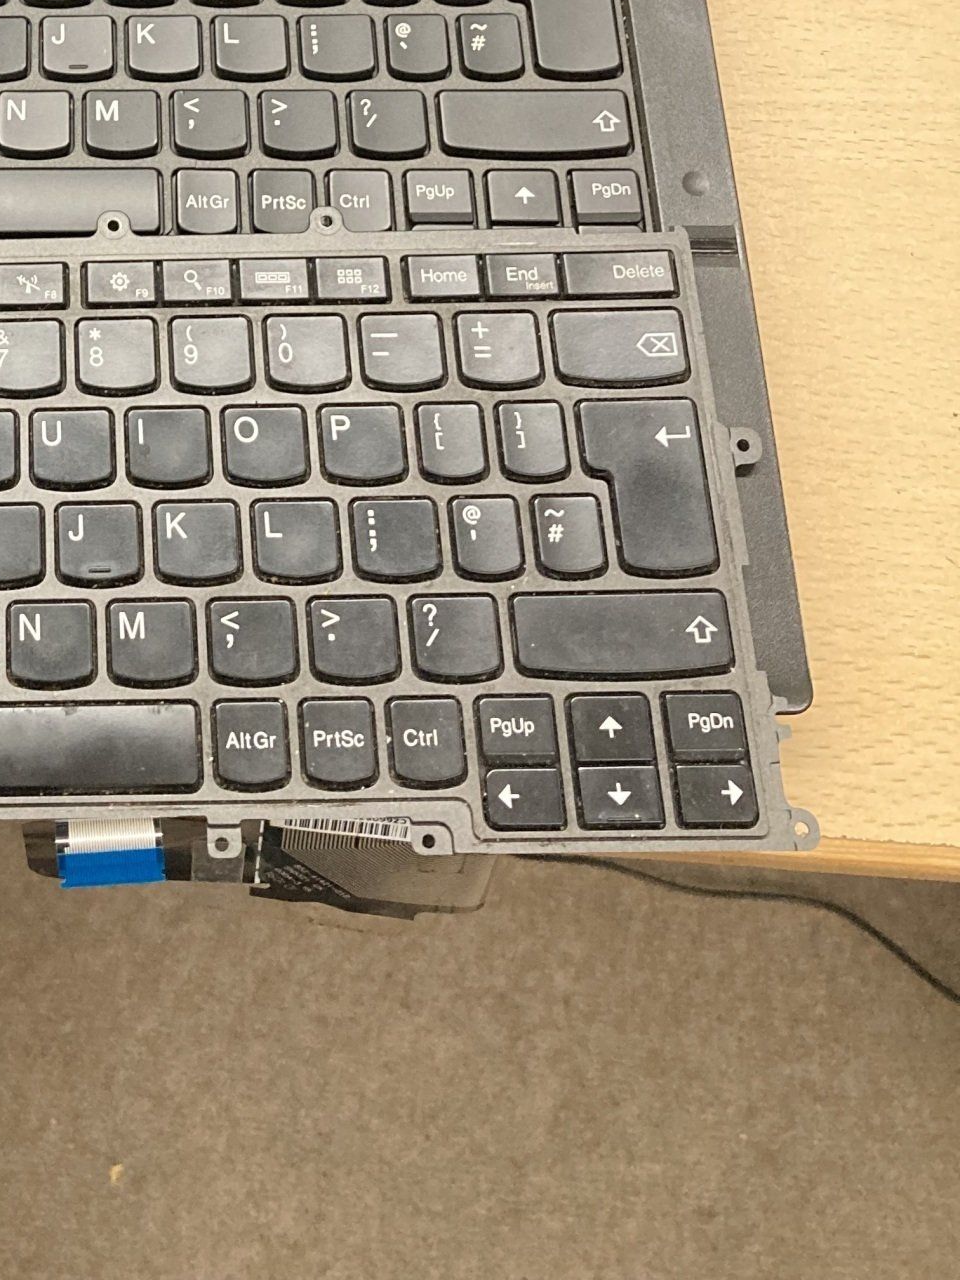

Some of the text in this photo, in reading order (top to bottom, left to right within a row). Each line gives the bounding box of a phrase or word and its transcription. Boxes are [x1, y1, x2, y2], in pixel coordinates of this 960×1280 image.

[51, 23, 66, 45] J
[136, 23, 156, 45] K
[223, 22, 240, 44] L
[394, 22, 412, 39] @
[470, 34, 486, 51] #
[6, 99, 26, 121] N
[95, 99, 119, 122] M
[360, 98, 372, 116] ?
[415, 184, 455, 200] PgUp
[591, 182, 632, 199] PgDn
[185, 194, 230, 209] AltGr
[261, 194, 307, 210] PrtSc
[339, 193, 370, 209] Ctrl
[420, 268, 468, 283] Home
[505, 266, 539, 282] End
[612, 264, 665, 279] Delete
[44, 289, 57, 300] F8
[135, 288, 149, 298] F9
[206, 286, 225, 296] F10
[285, 284, 302, 294] F11
[360, 283, 380, 294] F12
[525, 281, 554, 291] Insert
[89, 346, 104, 368] 8
[183, 344, 199, 365] 9
[278, 342, 294, 363] 0
[41, 420, 62, 447] U
[137, 418, 144, 445] I
[233, 416, 259, 444] O
[330, 414, 351, 441] P
[165, 511, 188, 539] K
[263, 510, 283, 539] L
[462, 505, 482, 525] @
[68, 513, 84, 542] J
[547, 523, 565, 543] #
[422, 603, 438, 627] ?
[19, 613, 41, 642] N
[118, 611, 146, 640] M
[489, 717, 535, 738] PgUp
[687, 712, 734, 733] PgDn
[225, 731, 277, 750] AltGr
[313, 729, 365, 748] PrtSc
[403, 728, 439, 747] Ctrl
